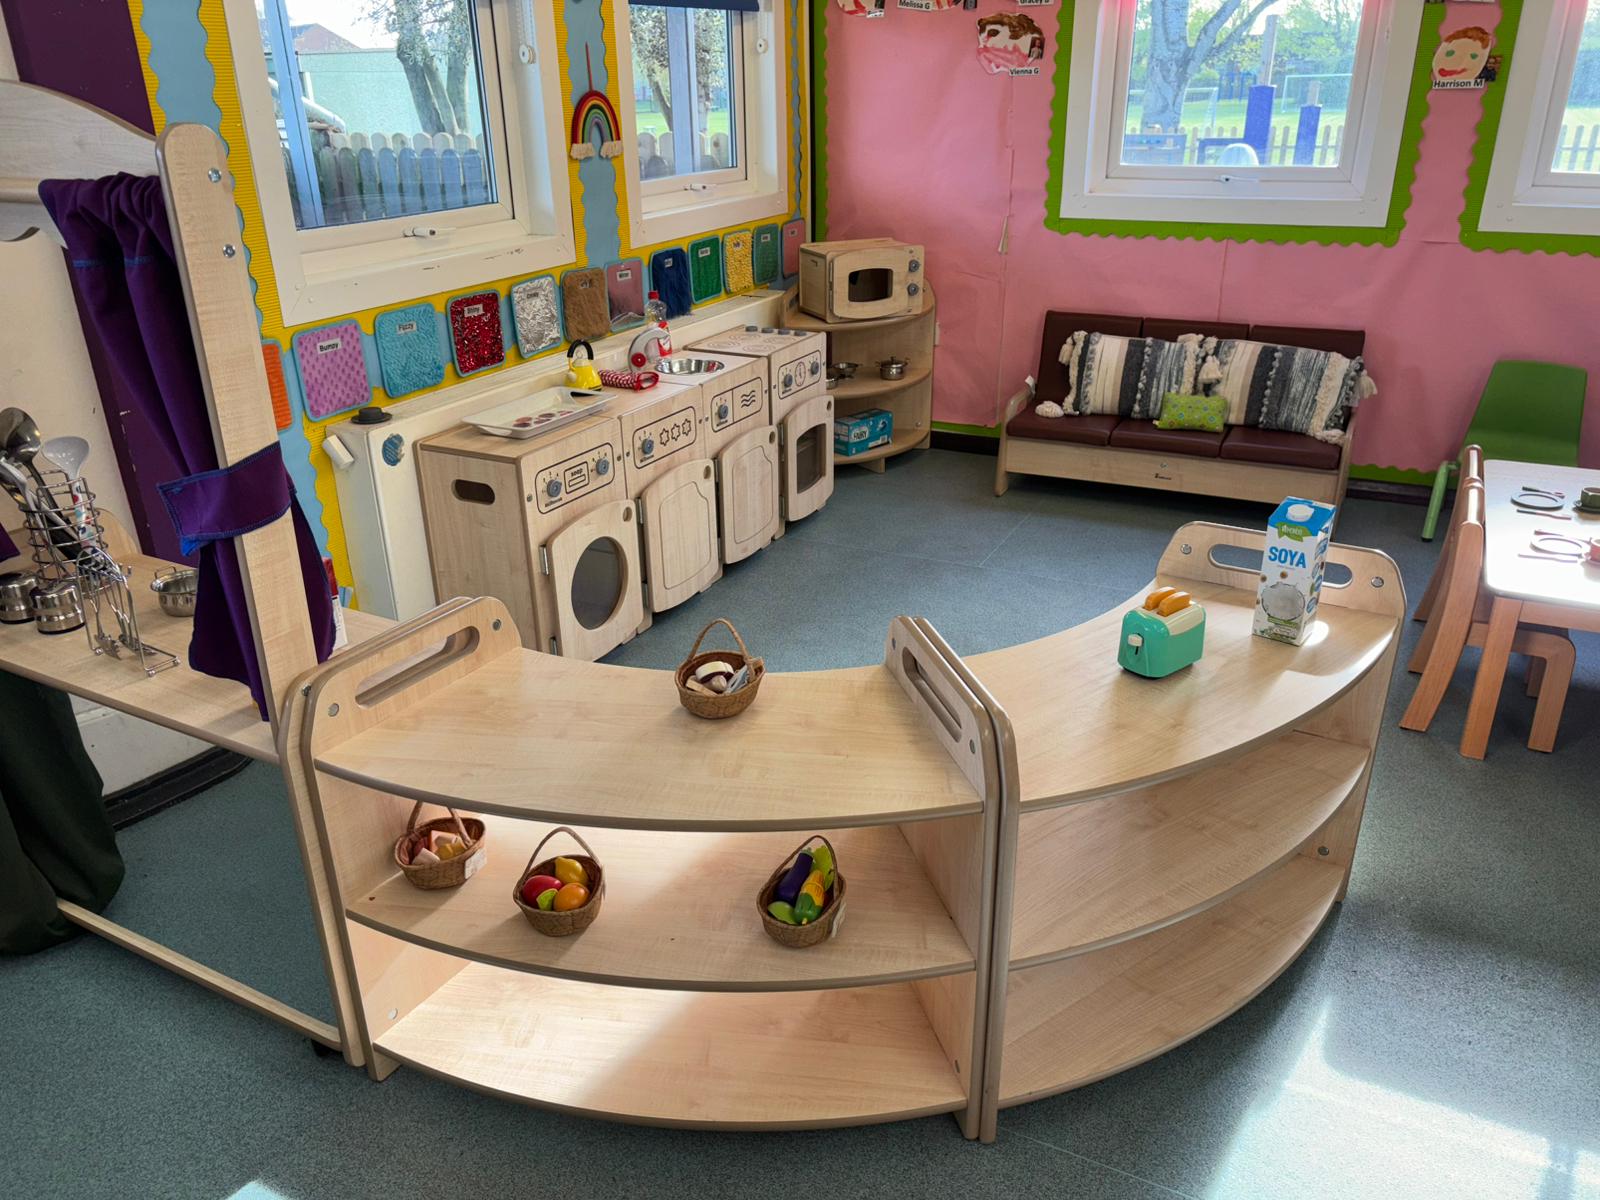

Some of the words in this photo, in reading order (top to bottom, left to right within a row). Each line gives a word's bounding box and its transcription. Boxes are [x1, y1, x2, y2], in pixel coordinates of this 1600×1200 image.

[900, 0, 923, 9] Melissa
[1433, 80, 1471, 88] Harrison
[1473, 79, 1483, 87] M
[319, 342, 339, 352] Bumpy
[1268, 546, 1307, 568] SOYA
